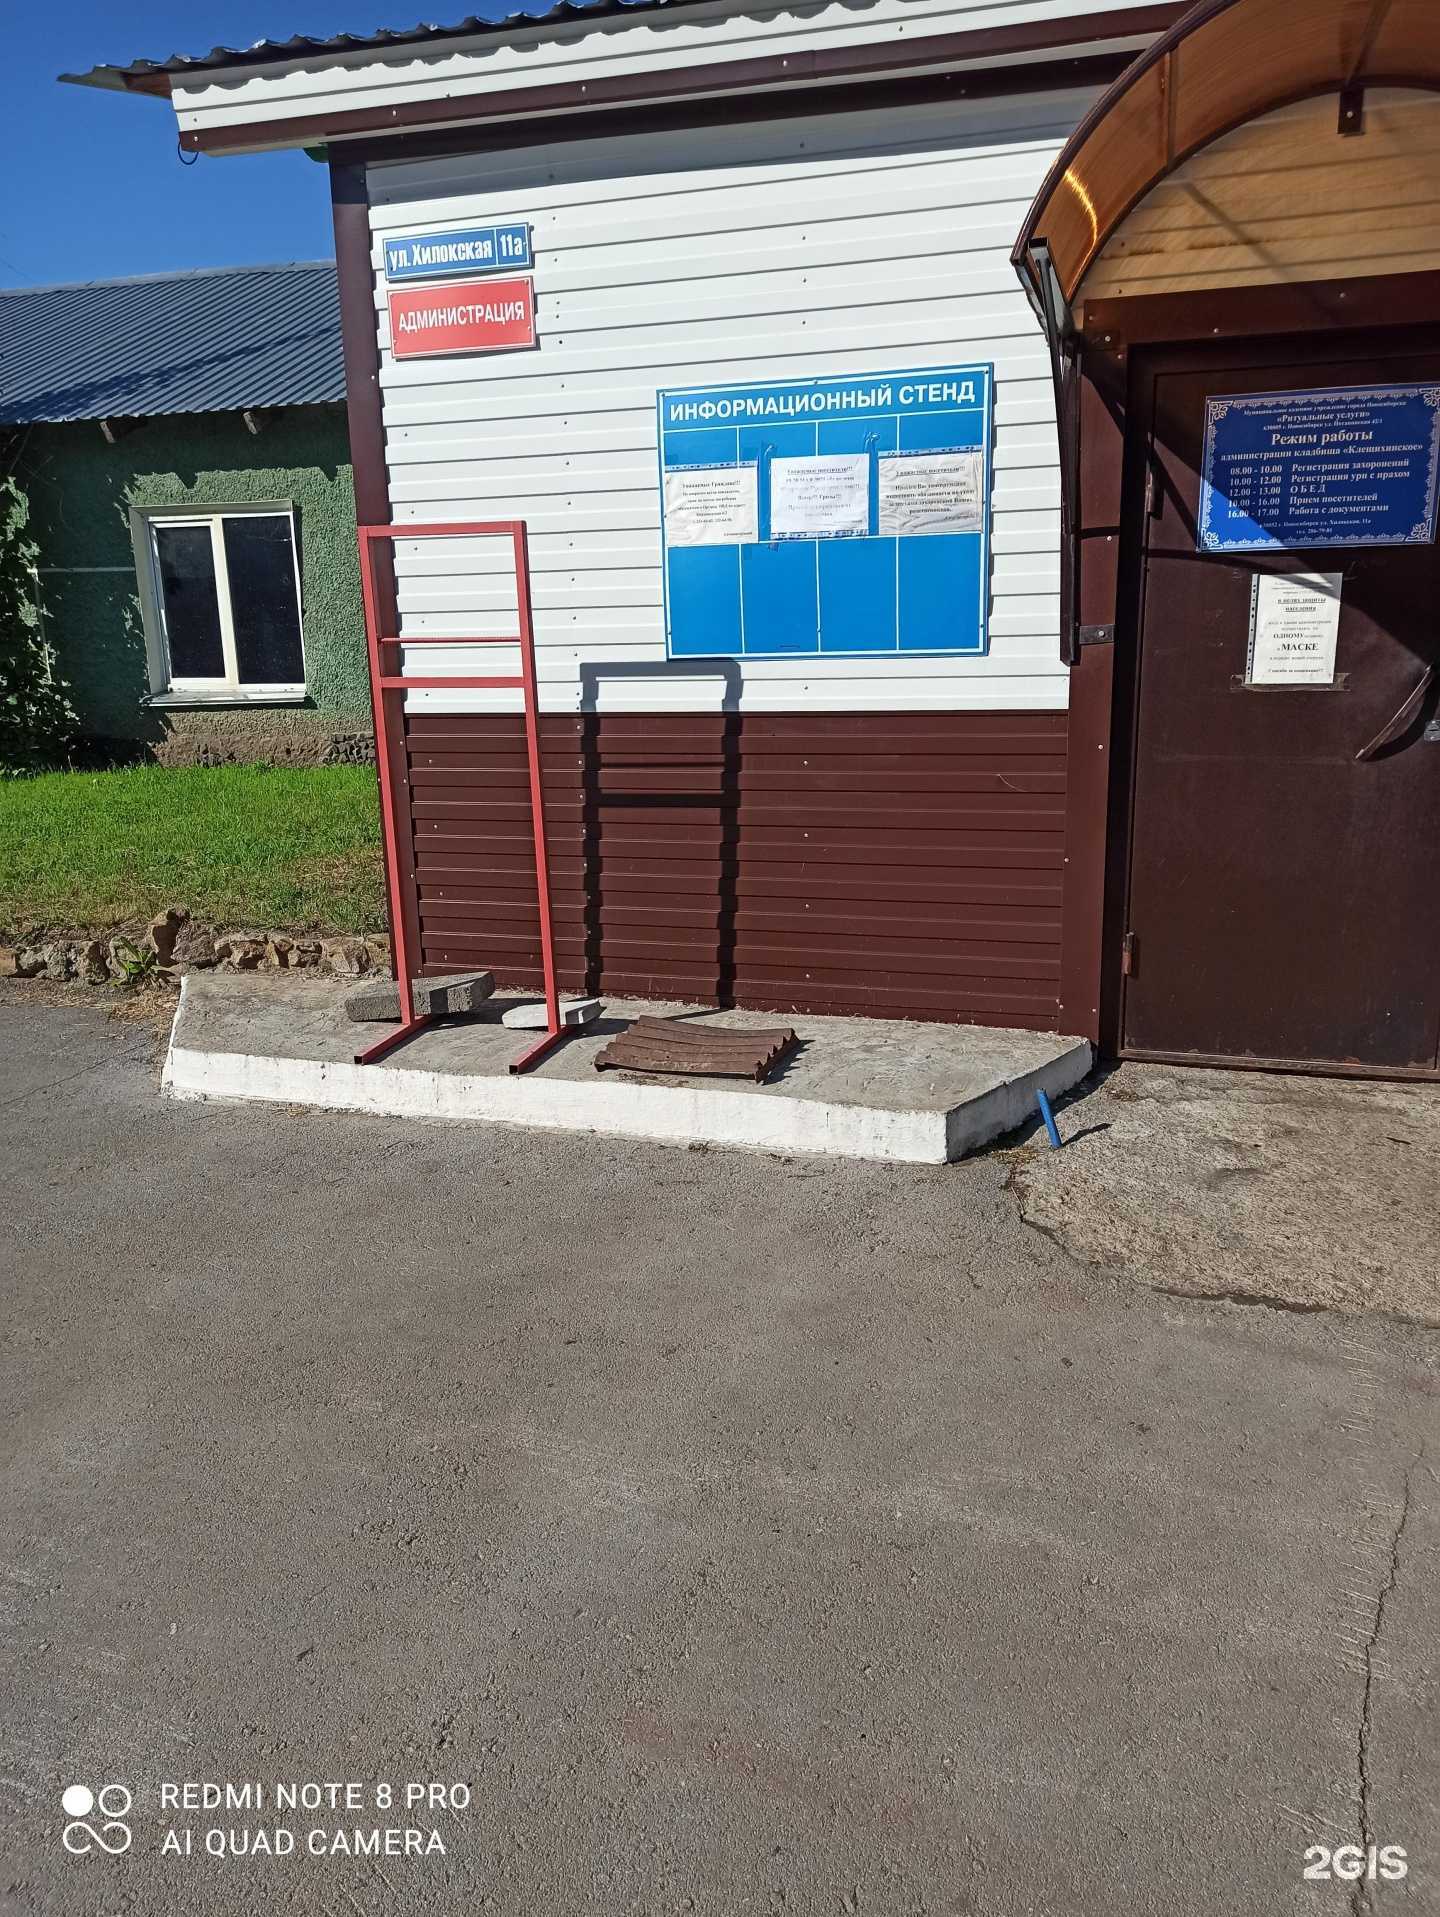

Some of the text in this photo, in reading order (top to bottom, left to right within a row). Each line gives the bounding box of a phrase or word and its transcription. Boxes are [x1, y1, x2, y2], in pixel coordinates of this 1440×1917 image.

[500, 234, 523, 257] 11а
[399, 301, 525, 333] АДМИНИСТРАЦИЯ
[670, 381, 976, 421] ИНФОРМАЦИОННЫЙ СТЕНД
[1277, 411, 1370, 424] «Ритуальные услуги»
[1271, 429, 1373, 446] Режим работы
[1221, 450, 1291, 461] администрации
[1230, 467, 1252, 476] 08.00
[1260, 465, 1282, 474] 10.00
[1352, 459, 1409, 470] захоронений
[1230, 477, 1252, 486] 10.00
[1260, 476, 1282, 485] 12.00
[1351, 473, 1368, 482] урн
[1377, 471, 1410, 481] прахом
[1229, 488, 1251, 497] 12.00
[1259, 486, 1281, 495] 13.00
[1258, 497, 1280, 506] 16.00
[1322, 492, 1378, 503] посетителей
[1228, 510, 1248, 518] 16.00
[1257, 508, 1280, 517] 17.00
[1289, 506, 1319, 515] Работа
[1328, 505, 1390, 514] документами
[1281, 642, 1319, 651] МАСКЕ
